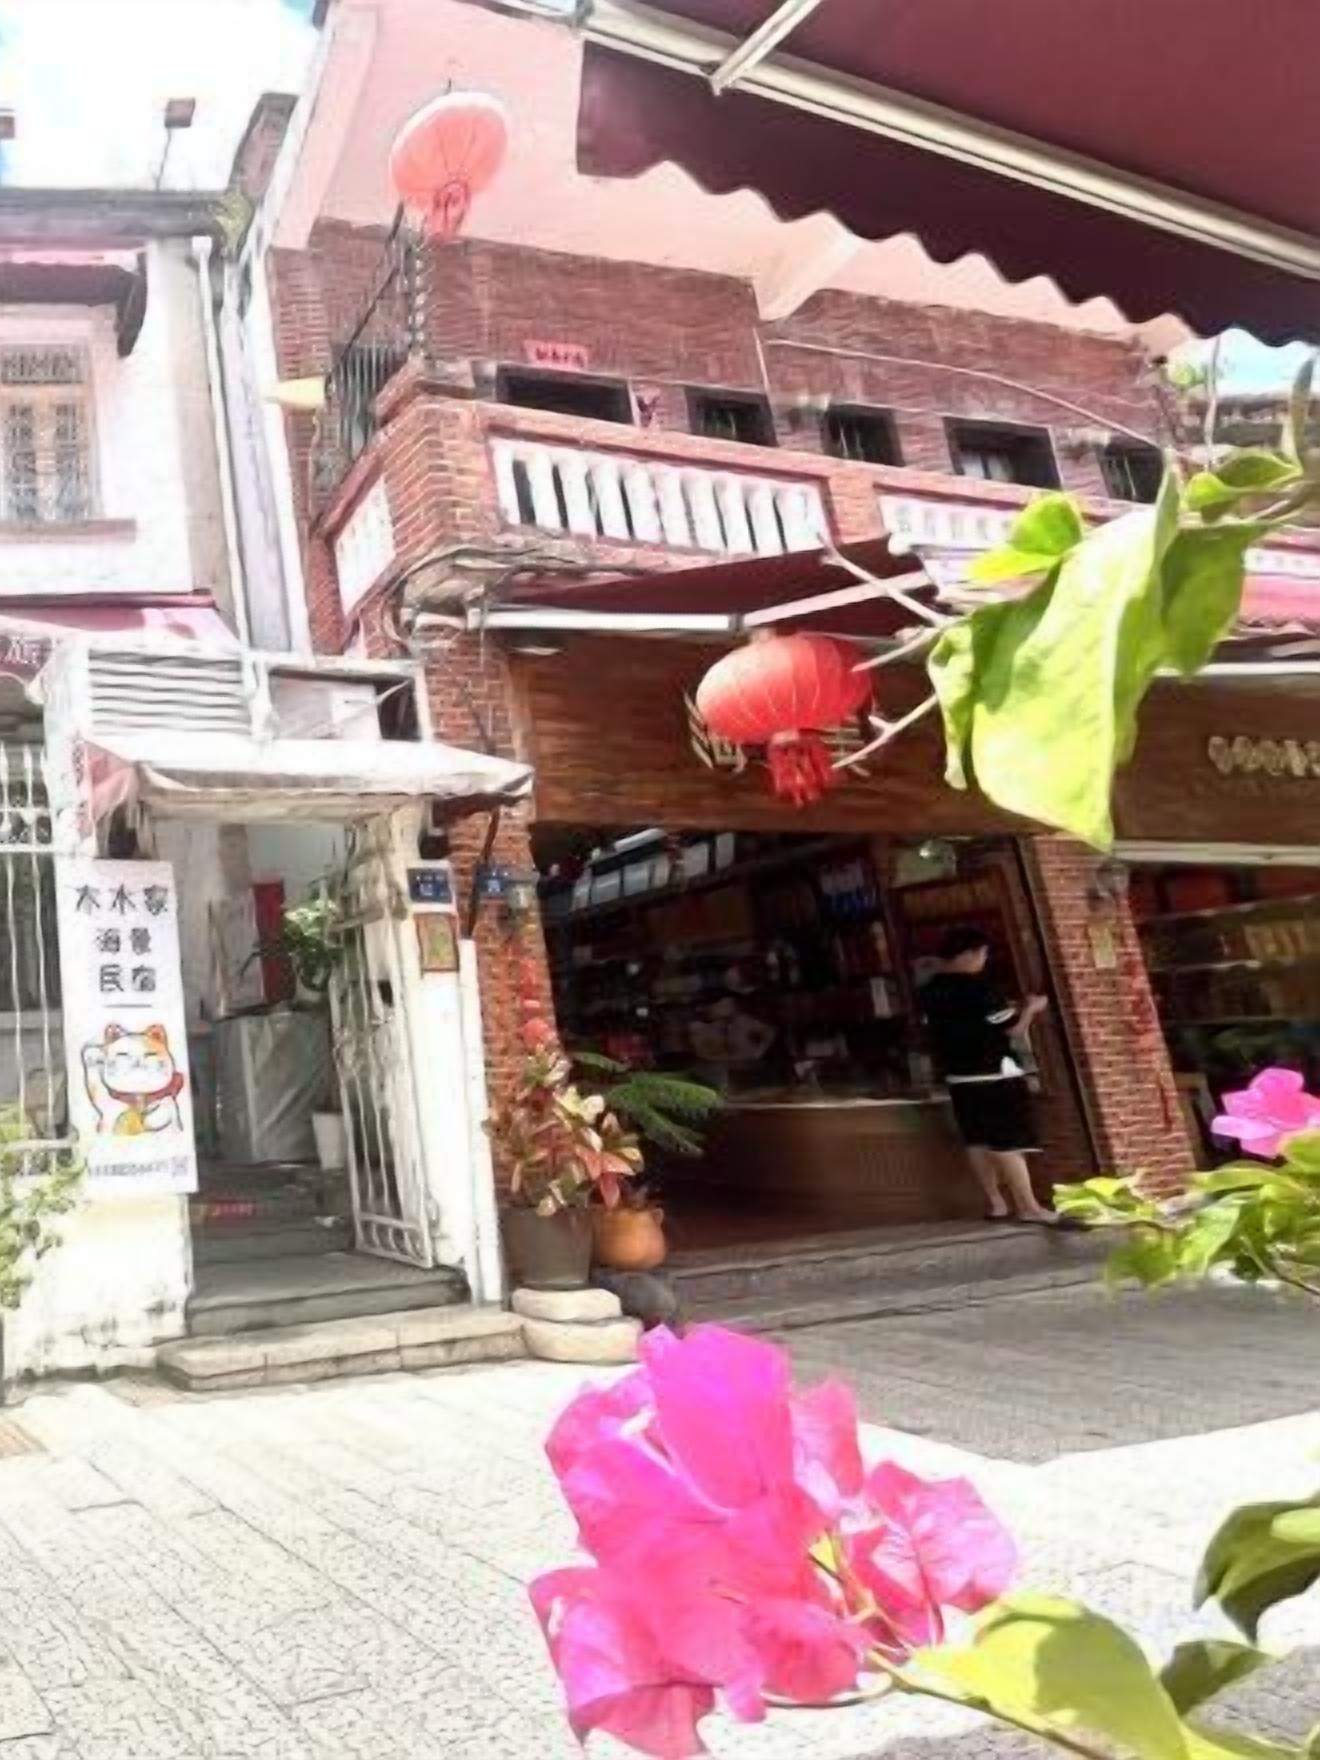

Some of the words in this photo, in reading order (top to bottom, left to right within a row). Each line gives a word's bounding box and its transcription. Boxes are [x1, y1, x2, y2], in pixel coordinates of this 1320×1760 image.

[75, 884, 168, 916] 木木家
[94, 927, 151, 955] 海景
[99, 964, 157, 993] 民宿
